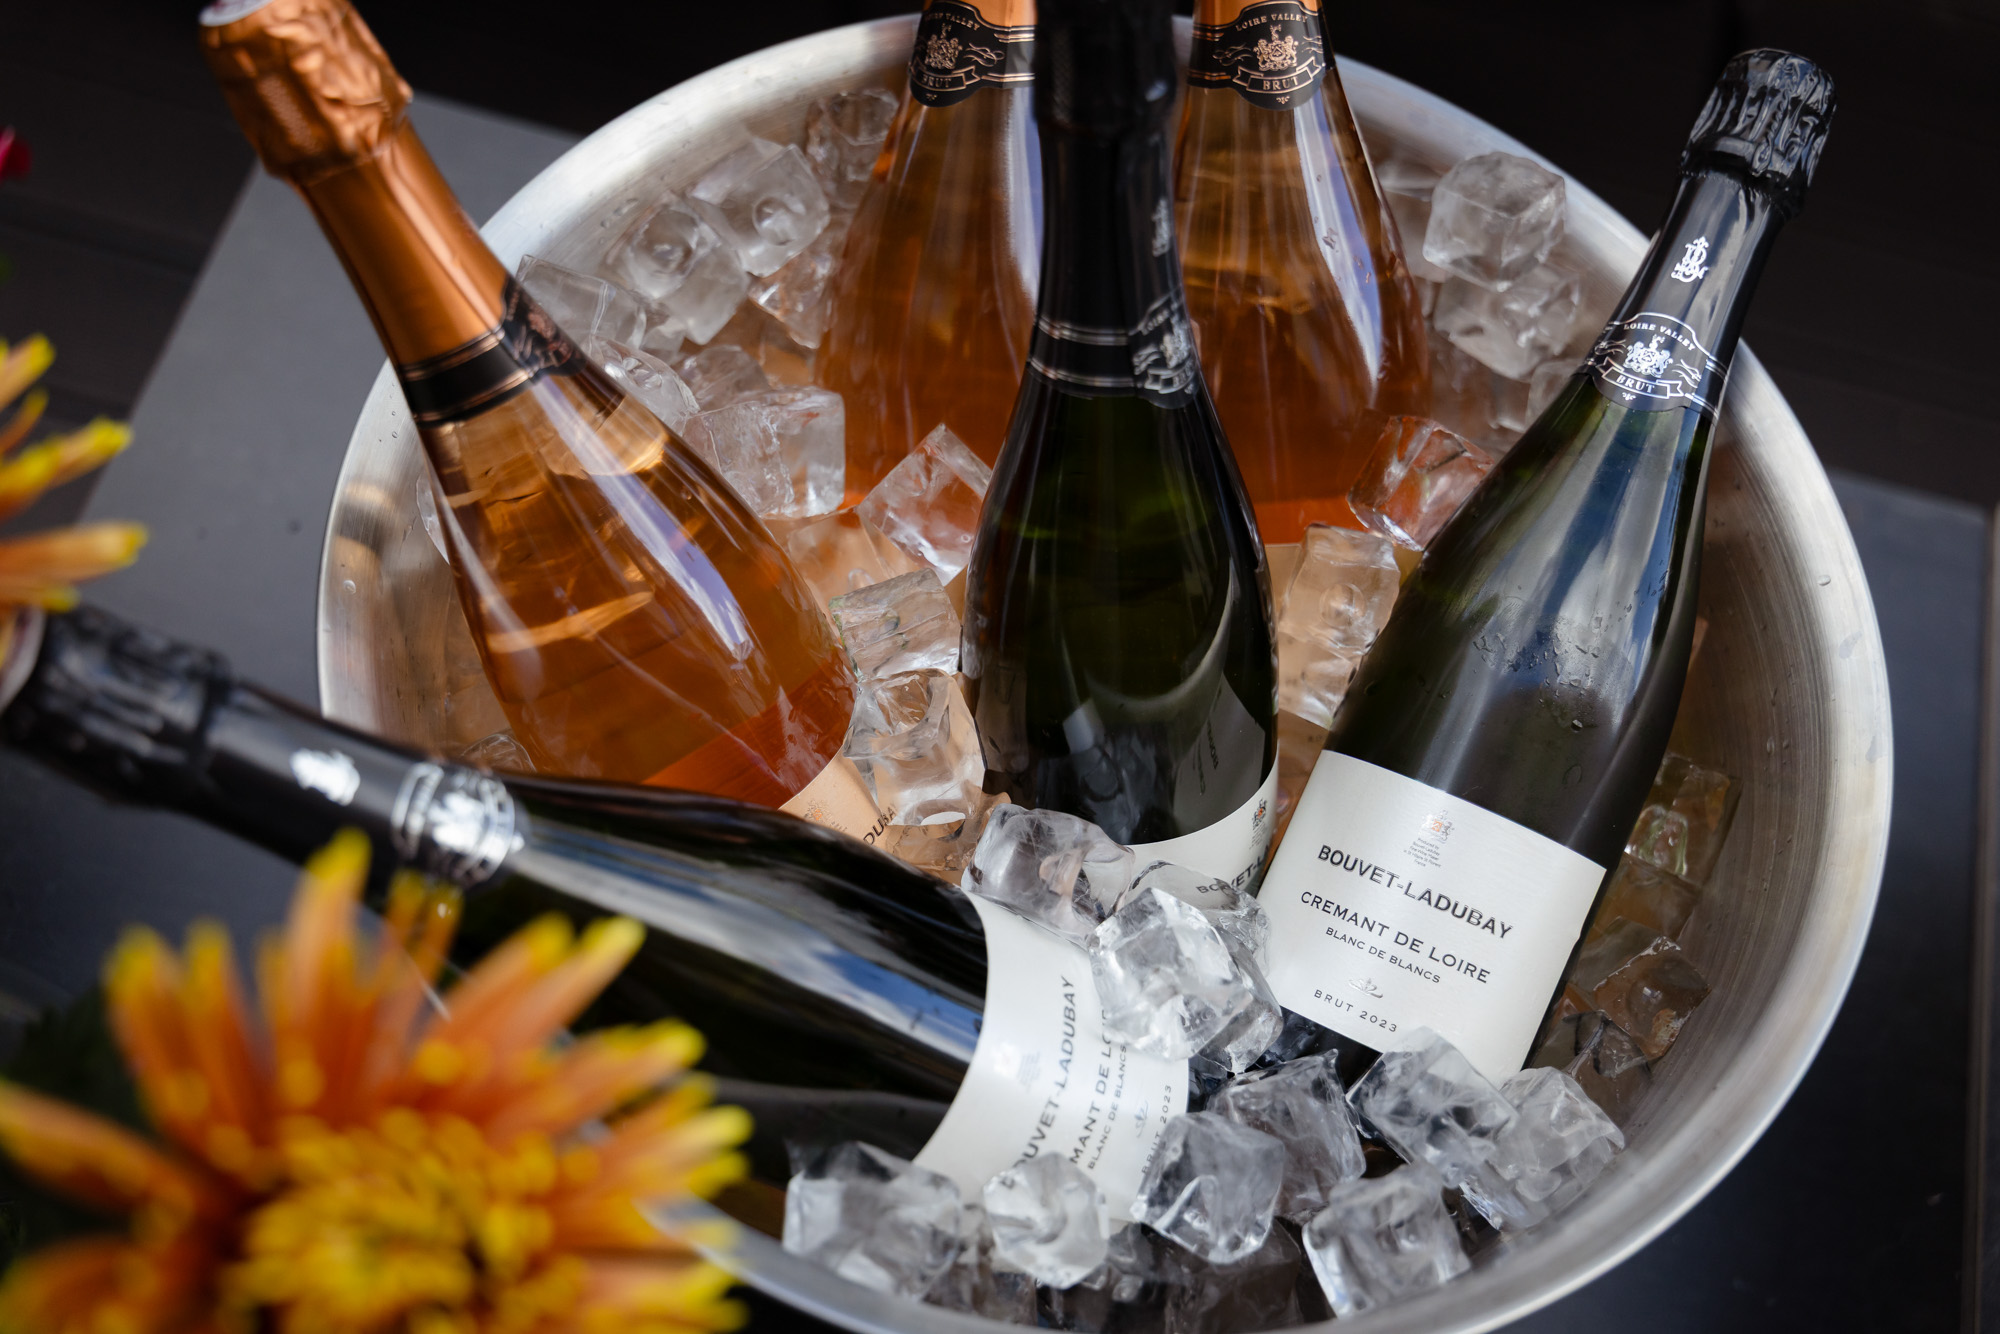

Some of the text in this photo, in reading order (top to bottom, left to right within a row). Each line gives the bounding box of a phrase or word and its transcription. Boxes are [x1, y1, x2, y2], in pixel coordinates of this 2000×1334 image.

[1235, 13, 1308, 32] LOIRE VALLEY
[1262, 76, 1299, 91] BRUT
[1623, 322, 1696, 351] LOIRE VALLEY
[1615, 374, 1656, 394] BRUT
[1317, 844, 1514, 940] BOUVET-LADUBAY
[1300, 890, 1492, 985] CREMANT DE LOIRE
[1325, 926, 1442, 984] BLANC DE BLANCS
[1313, 988, 1398, 1033] BRUT 2023
[1069, 1100, 1101, 1165] MANT
[1095, 1063, 1110, 1096] DE
[1088, 1044, 1127, 1170] BLANC DE BLANCS
[1160, 1085, 1172, 1125] 2023
